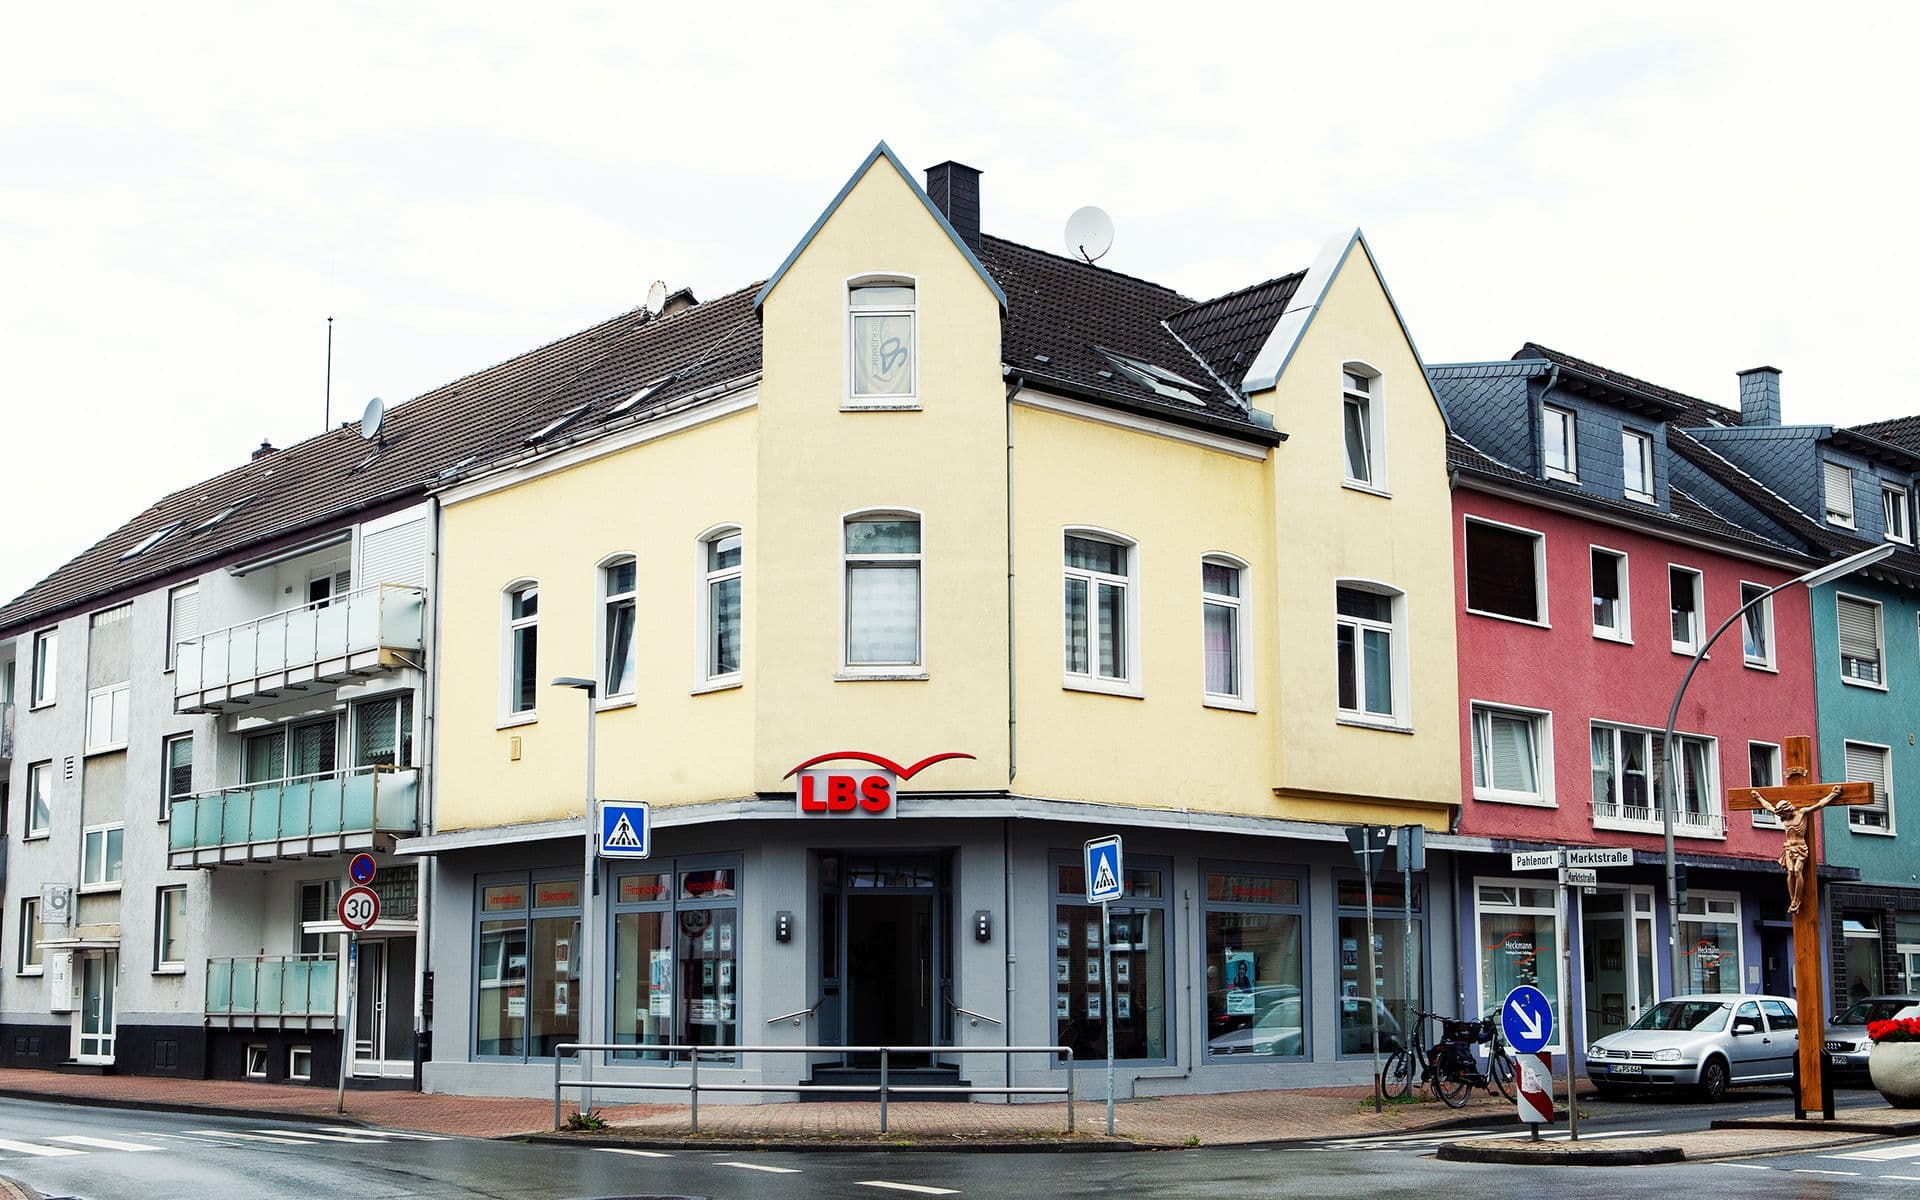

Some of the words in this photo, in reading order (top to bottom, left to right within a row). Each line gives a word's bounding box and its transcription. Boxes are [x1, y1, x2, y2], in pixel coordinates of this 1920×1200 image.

[801, 775, 891, 813] LBS
[1516, 855, 1553, 867] Pahlenort
[1570, 851, 1628, 864] Marktstraße
[347, 898, 372, 919] 30
[1505, 940, 1533, 950] Heckmann
